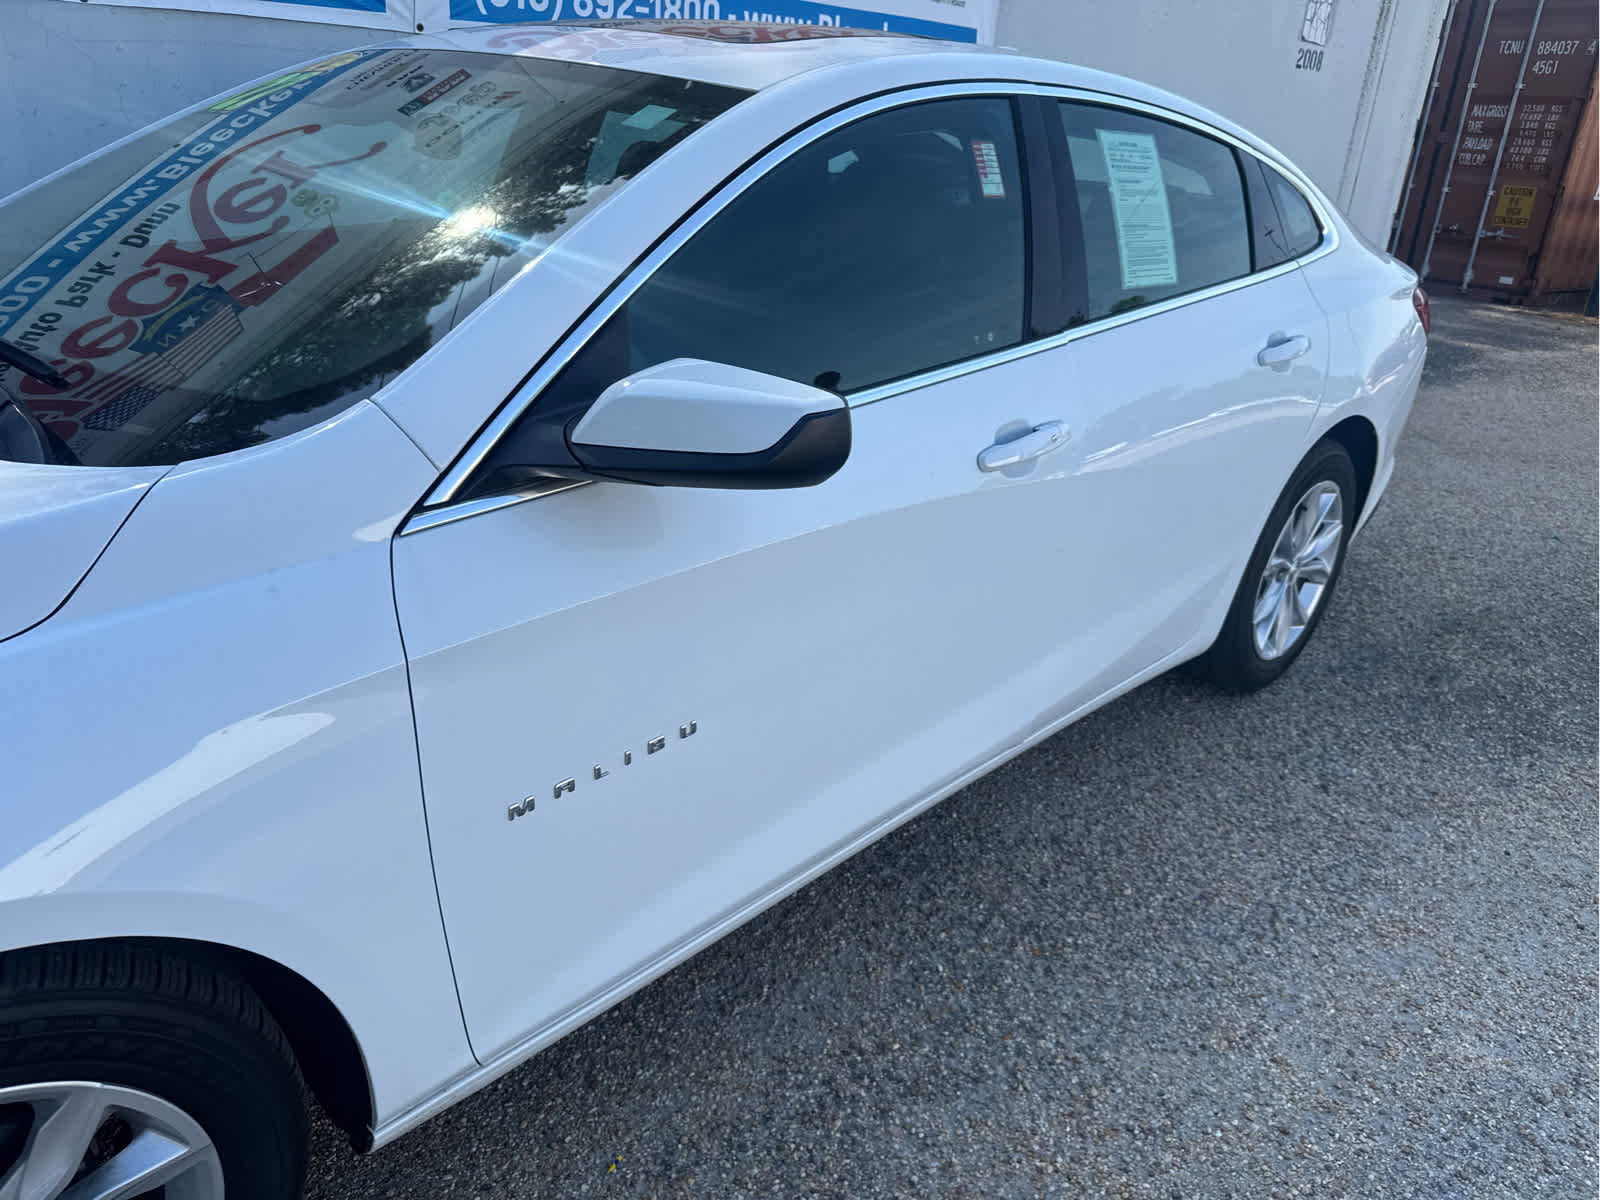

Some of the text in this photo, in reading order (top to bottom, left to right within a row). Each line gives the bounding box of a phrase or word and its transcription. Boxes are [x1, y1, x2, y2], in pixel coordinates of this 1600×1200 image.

[1499, 40, 1524, 54] TCNU
[1537, 40, 1580, 55] 884037
[1532, 61, 1559, 75] 45G1
[507, 719, 698, 822] MALIBU
